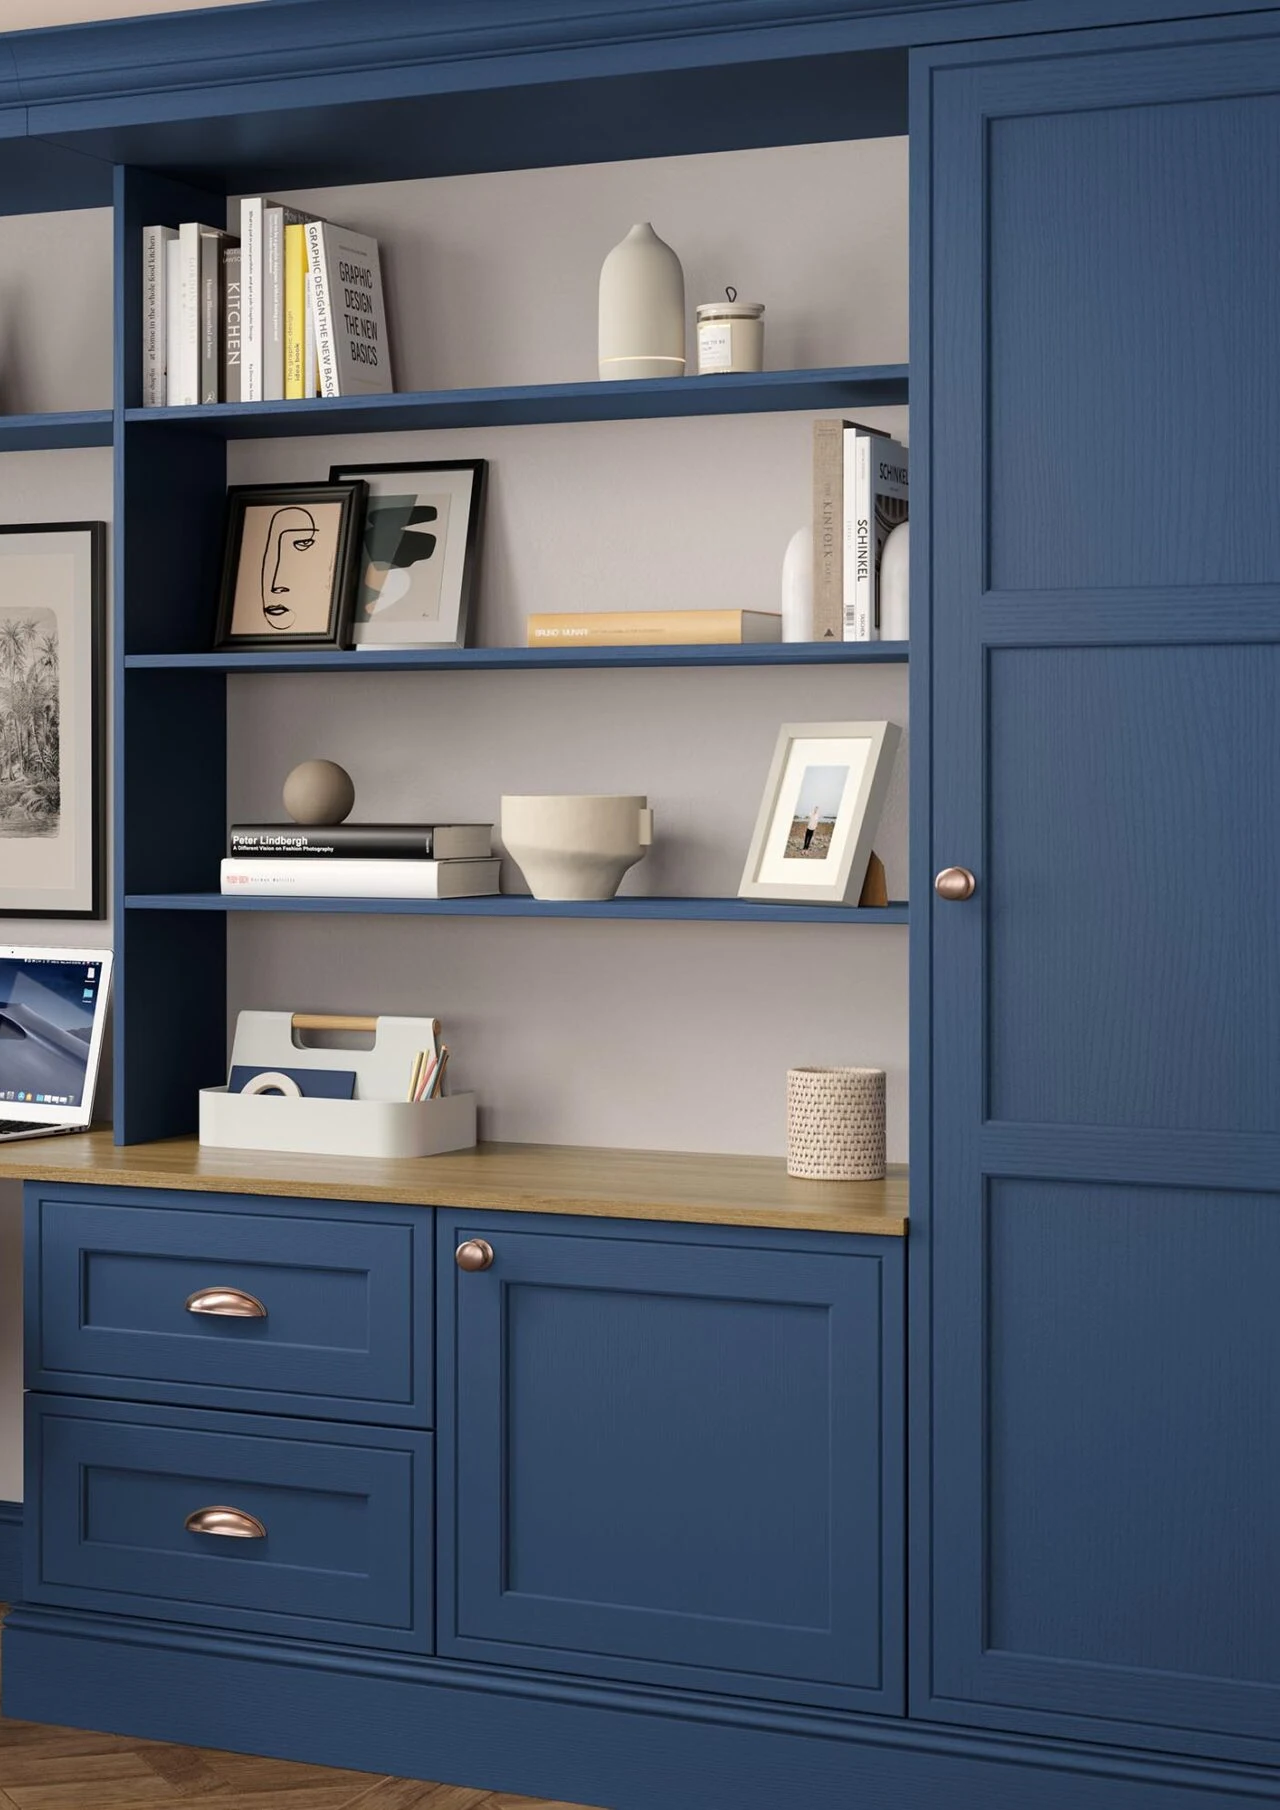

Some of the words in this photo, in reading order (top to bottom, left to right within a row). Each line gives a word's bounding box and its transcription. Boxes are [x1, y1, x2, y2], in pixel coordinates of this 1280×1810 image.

[147, 236, 155, 263] kitchen
[309, 226, 322, 274] GRAPHIC
[147, 265, 155, 281] food
[339, 262, 373, 289] GRAPHIC
[314, 275, 327, 316] DESIGN
[344, 289, 373, 314] DESIGN
[147, 321, 155, 329] in
[227, 282, 240, 365] KITCHEN
[319, 317, 328, 337] THE
[344, 314, 359, 336] THE
[360, 318, 378, 341] NEW
[321, 340, 331, 366] NEW
[351, 341, 378, 367] BASICS
[880, 462, 908, 486] SCHINKEL
[823, 501, 833, 558] KINFOLK
[858, 520, 868, 582] SCHINKEL
[233, 836, 258, 845] Peter
[260, 836, 308, 847] Lindbergh
